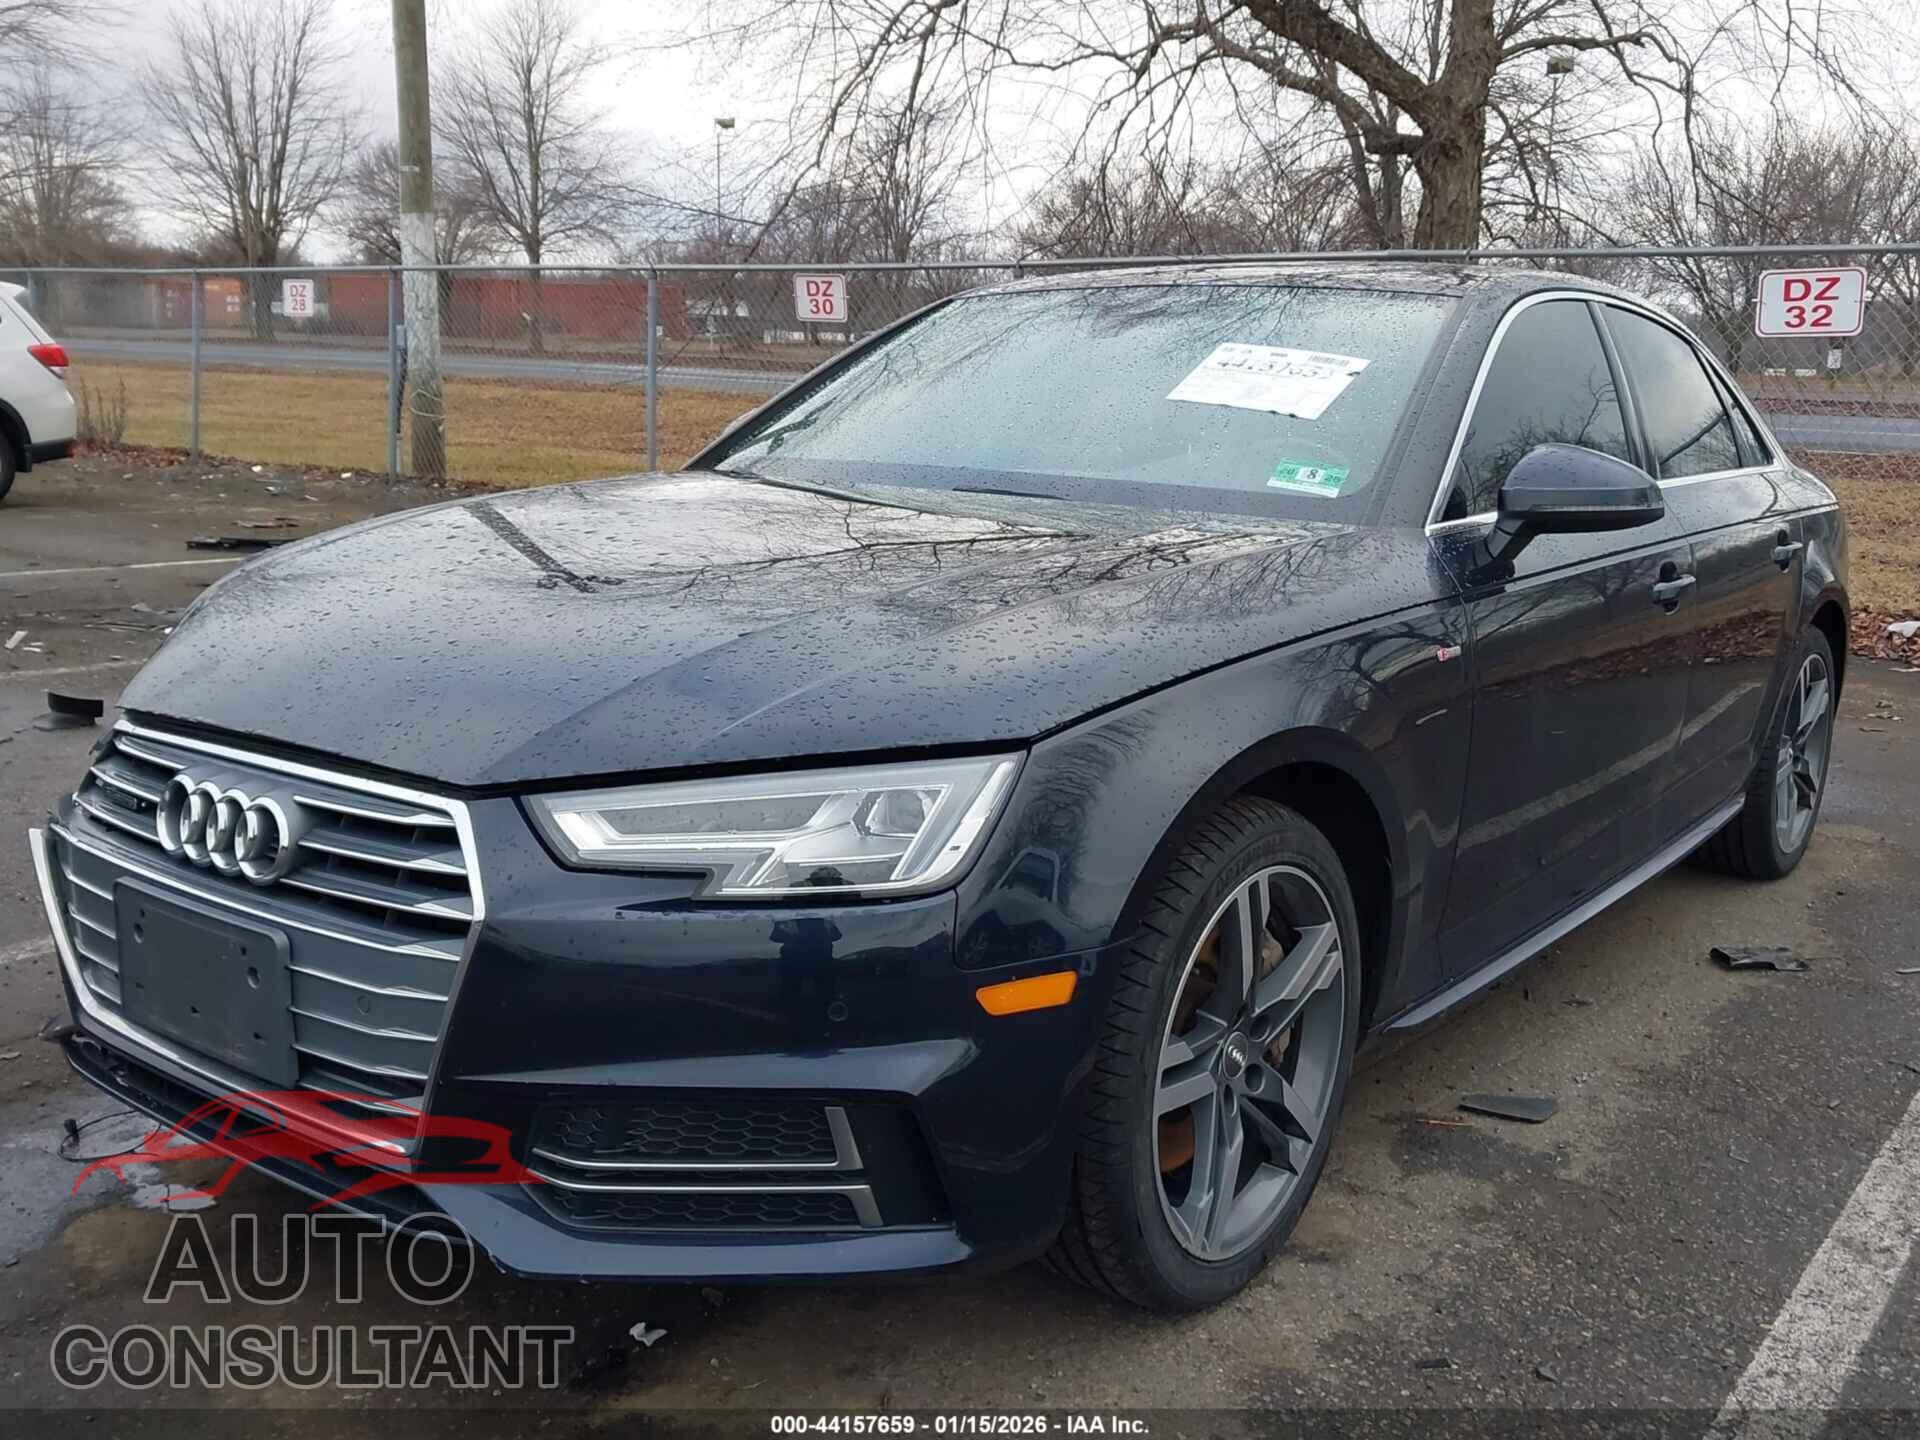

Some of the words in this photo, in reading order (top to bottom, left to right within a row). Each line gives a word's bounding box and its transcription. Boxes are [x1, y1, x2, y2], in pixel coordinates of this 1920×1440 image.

[289, 284, 307, 297] DZ
[806, 280, 834, 297] DZ
[1783, 276, 1841, 302] DZ
[809, 298, 834, 315] 30
[1784, 304, 1833, 329] 32
[1306, 468, 1320, 480] 8
